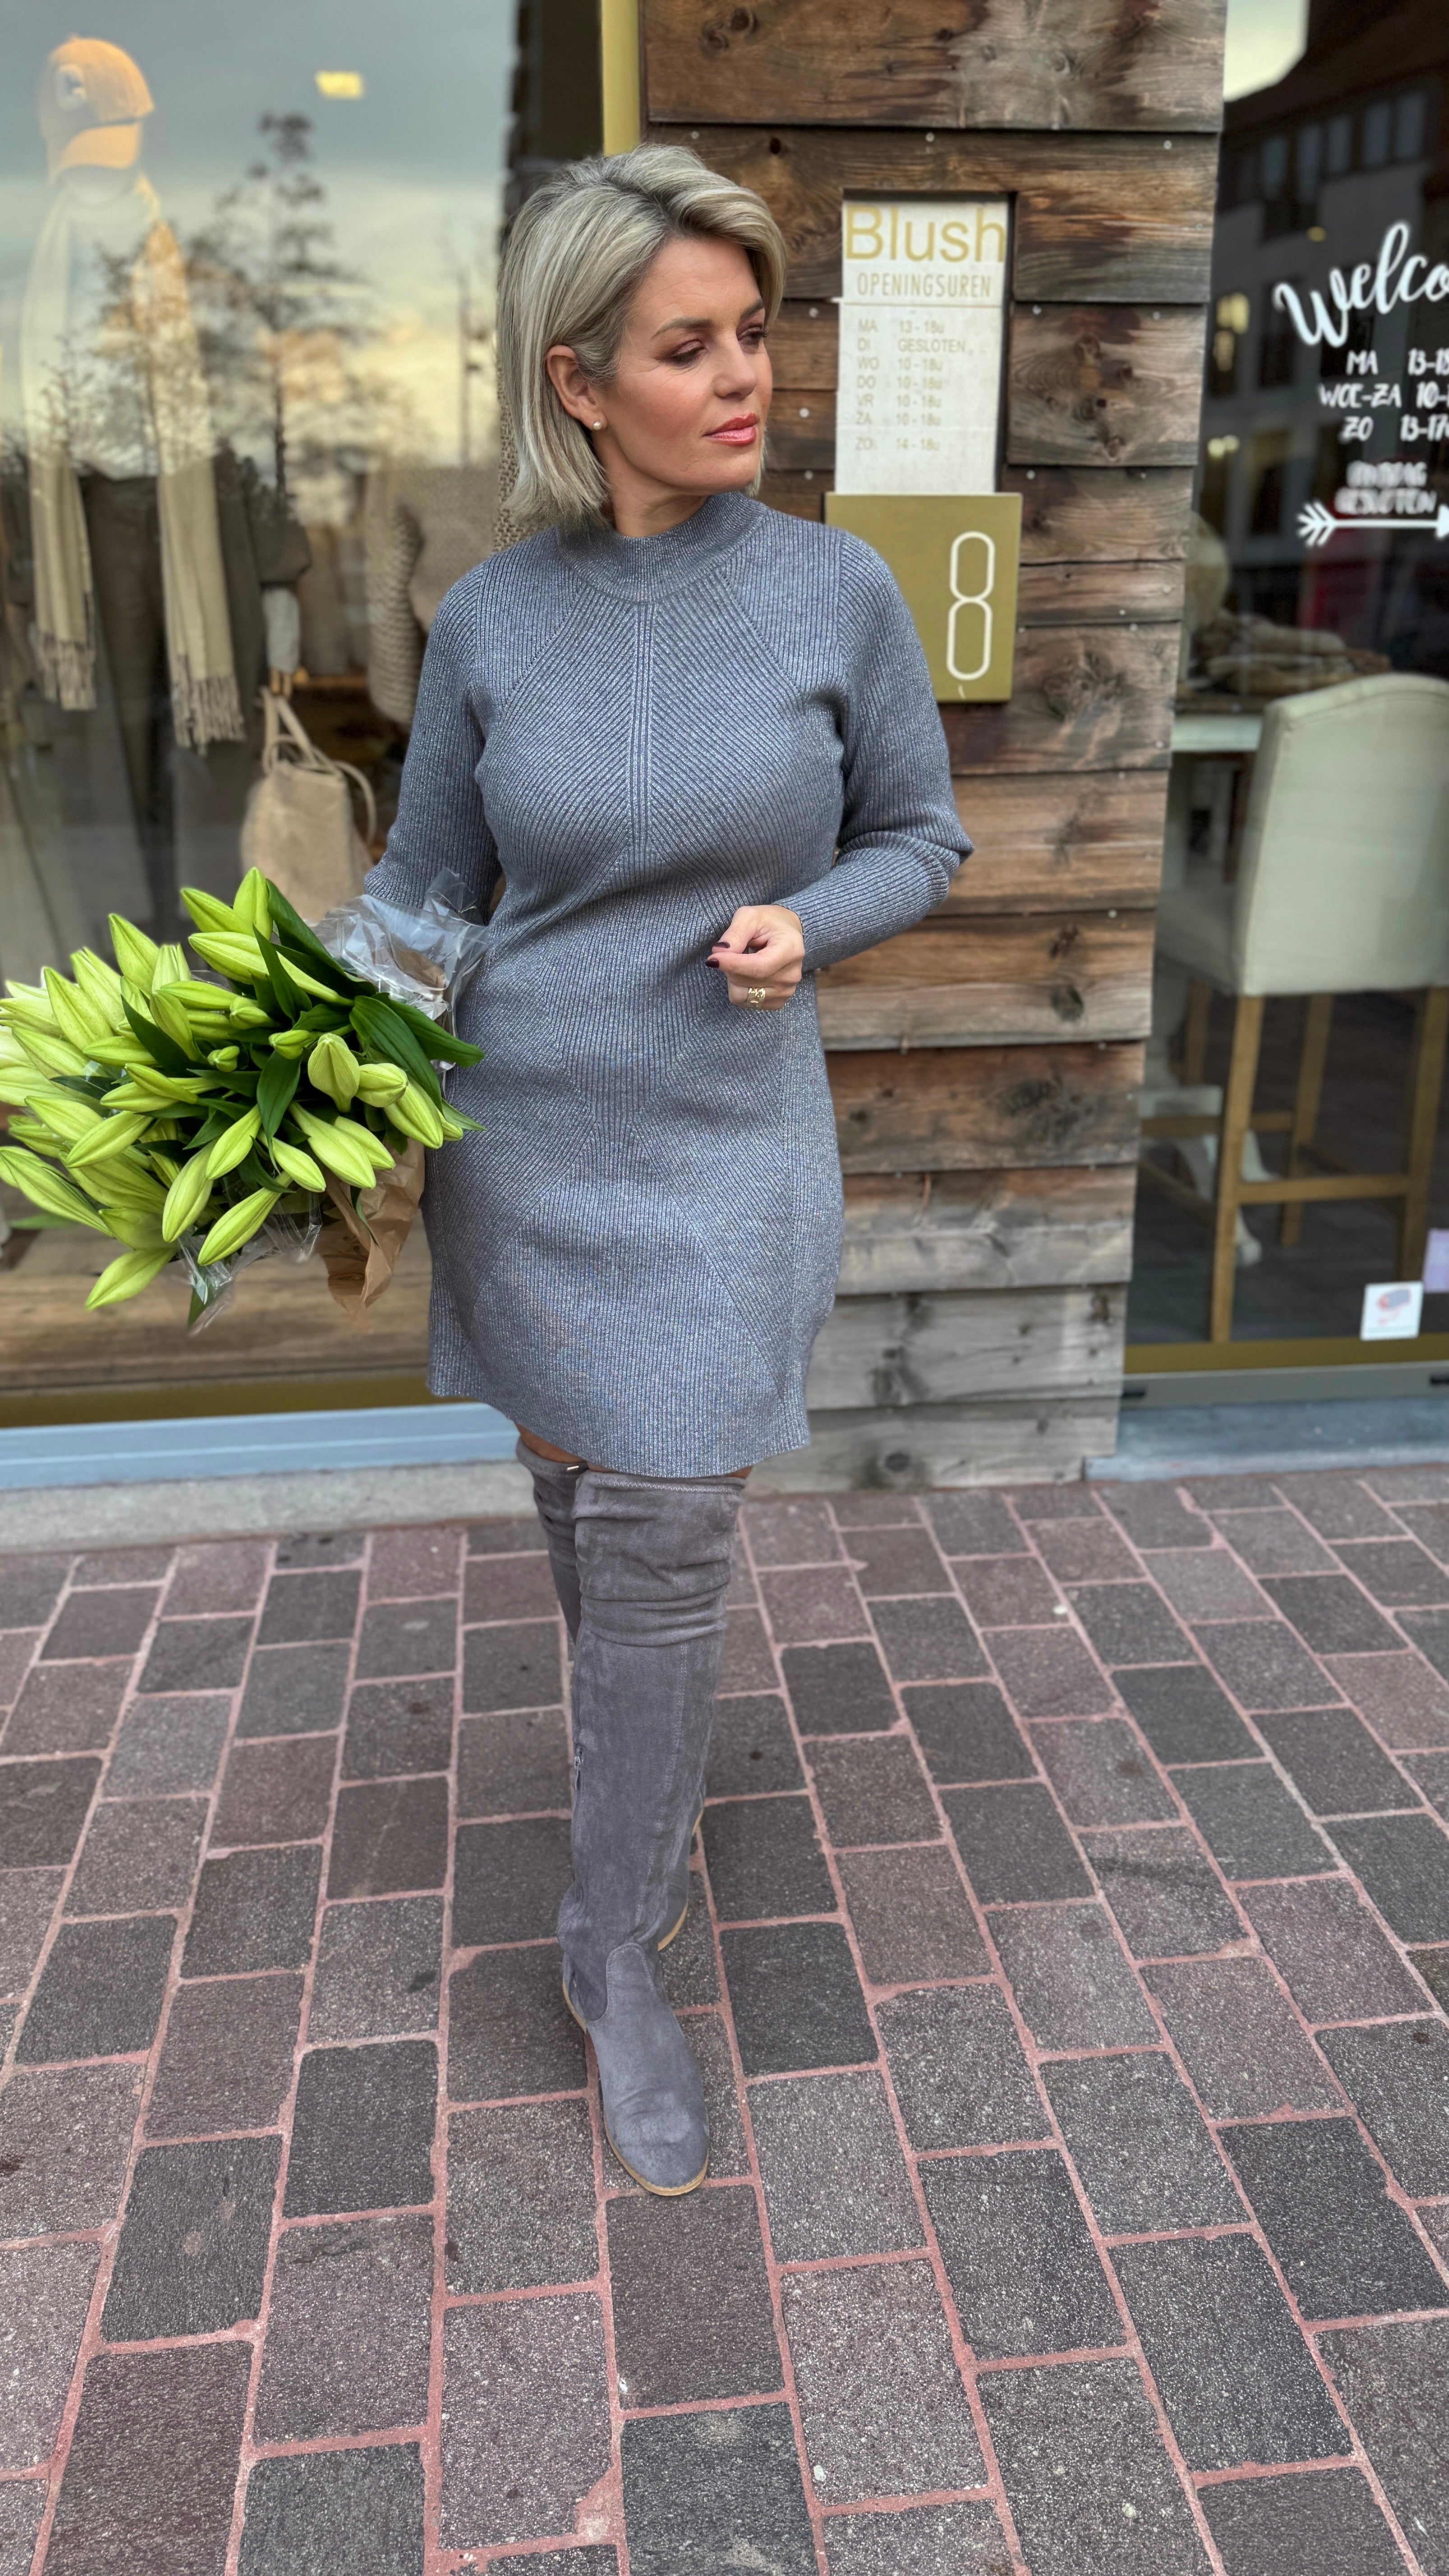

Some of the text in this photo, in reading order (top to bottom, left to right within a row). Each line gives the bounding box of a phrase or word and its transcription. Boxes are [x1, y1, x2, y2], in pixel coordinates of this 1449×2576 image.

[845, 205, 1006, 262] Blush
[857, 272, 992, 298] OPENINGSUREN
[858, 318, 878, 332] MA
[899, 320, 912, 333] 13
[857, 337, 966, 353] DI GESLOTEN
[857, 356, 879, 370] WO
[898, 357, 911, 371] 10
[1346, 350, 1379, 375] MA
[856, 375, 877, 389] DO
[897, 375, 911, 389] 10
[856, 410, 873, 425] ZA
[897, 412, 910, 426] 10
[1339, 415, 1374, 442] ZO
[947, 531, 995, 681] 8
